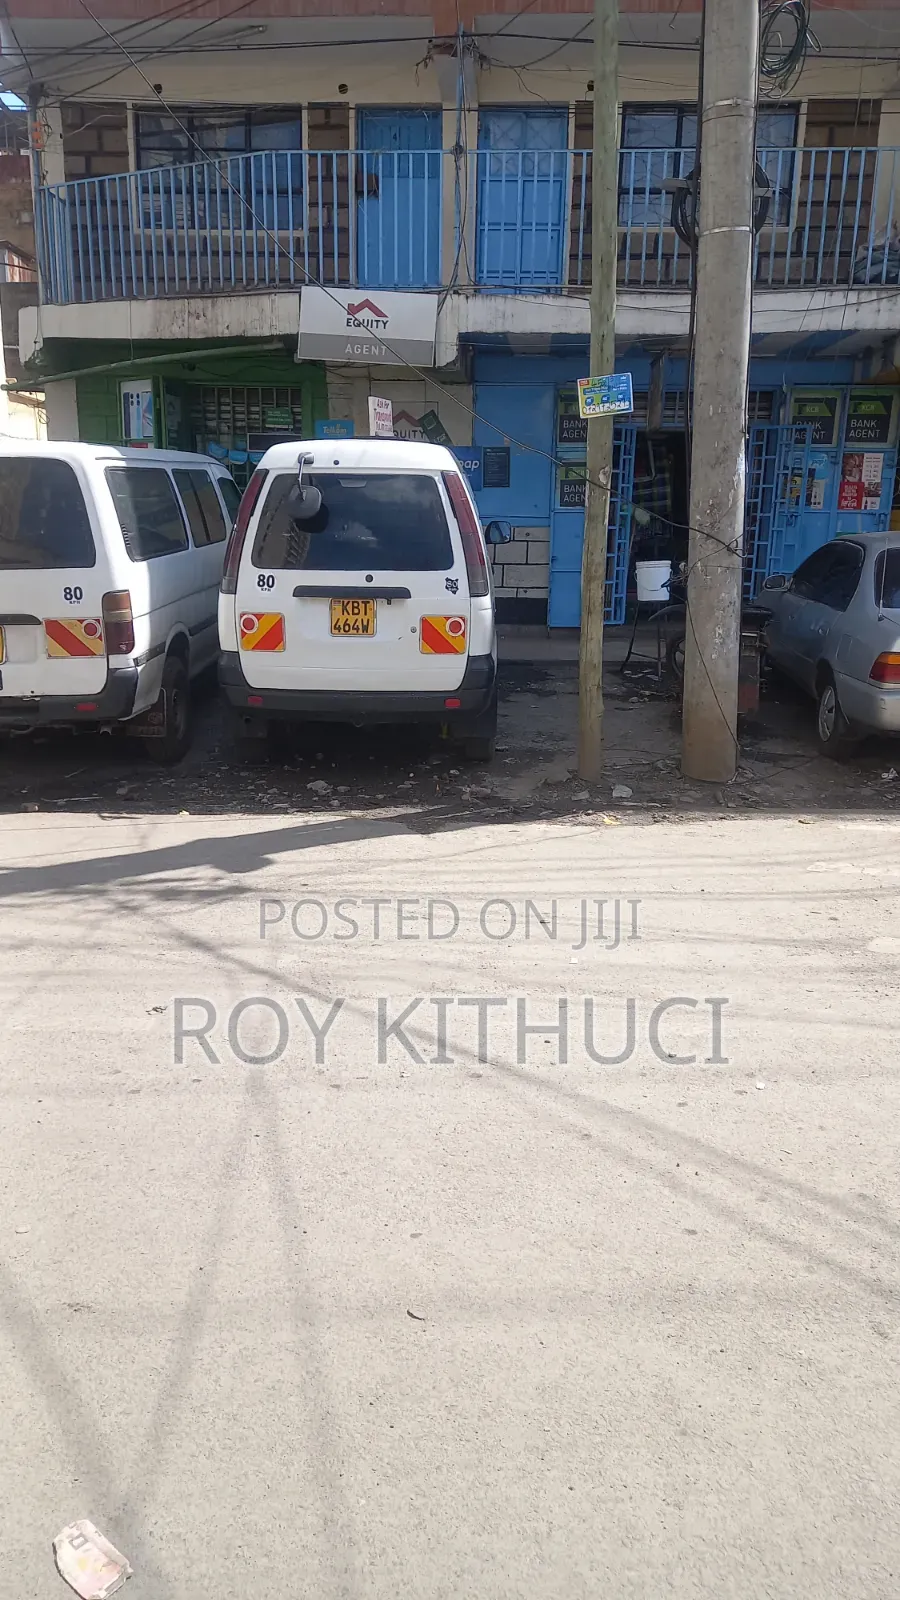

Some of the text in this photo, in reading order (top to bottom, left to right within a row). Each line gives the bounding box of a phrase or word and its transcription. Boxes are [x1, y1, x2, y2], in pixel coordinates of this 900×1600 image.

[346, 318, 389, 329] EQUITY
[345, 343, 387, 356] AGENT
[563, 420, 588, 428] BANK
[850, 419, 877, 428] BANK
[393, 429, 425, 439] QUITY
[563, 430, 587, 438] AGEN
[795, 431, 825, 440] AGNT
[849, 429, 880, 438] AGENT
[564, 494, 586, 502] AGEN
[257, 574, 275, 588] 80
[63, 586, 83, 601] 80
[341, 600, 371, 615] KBT
[333, 618, 370, 634] 464W
